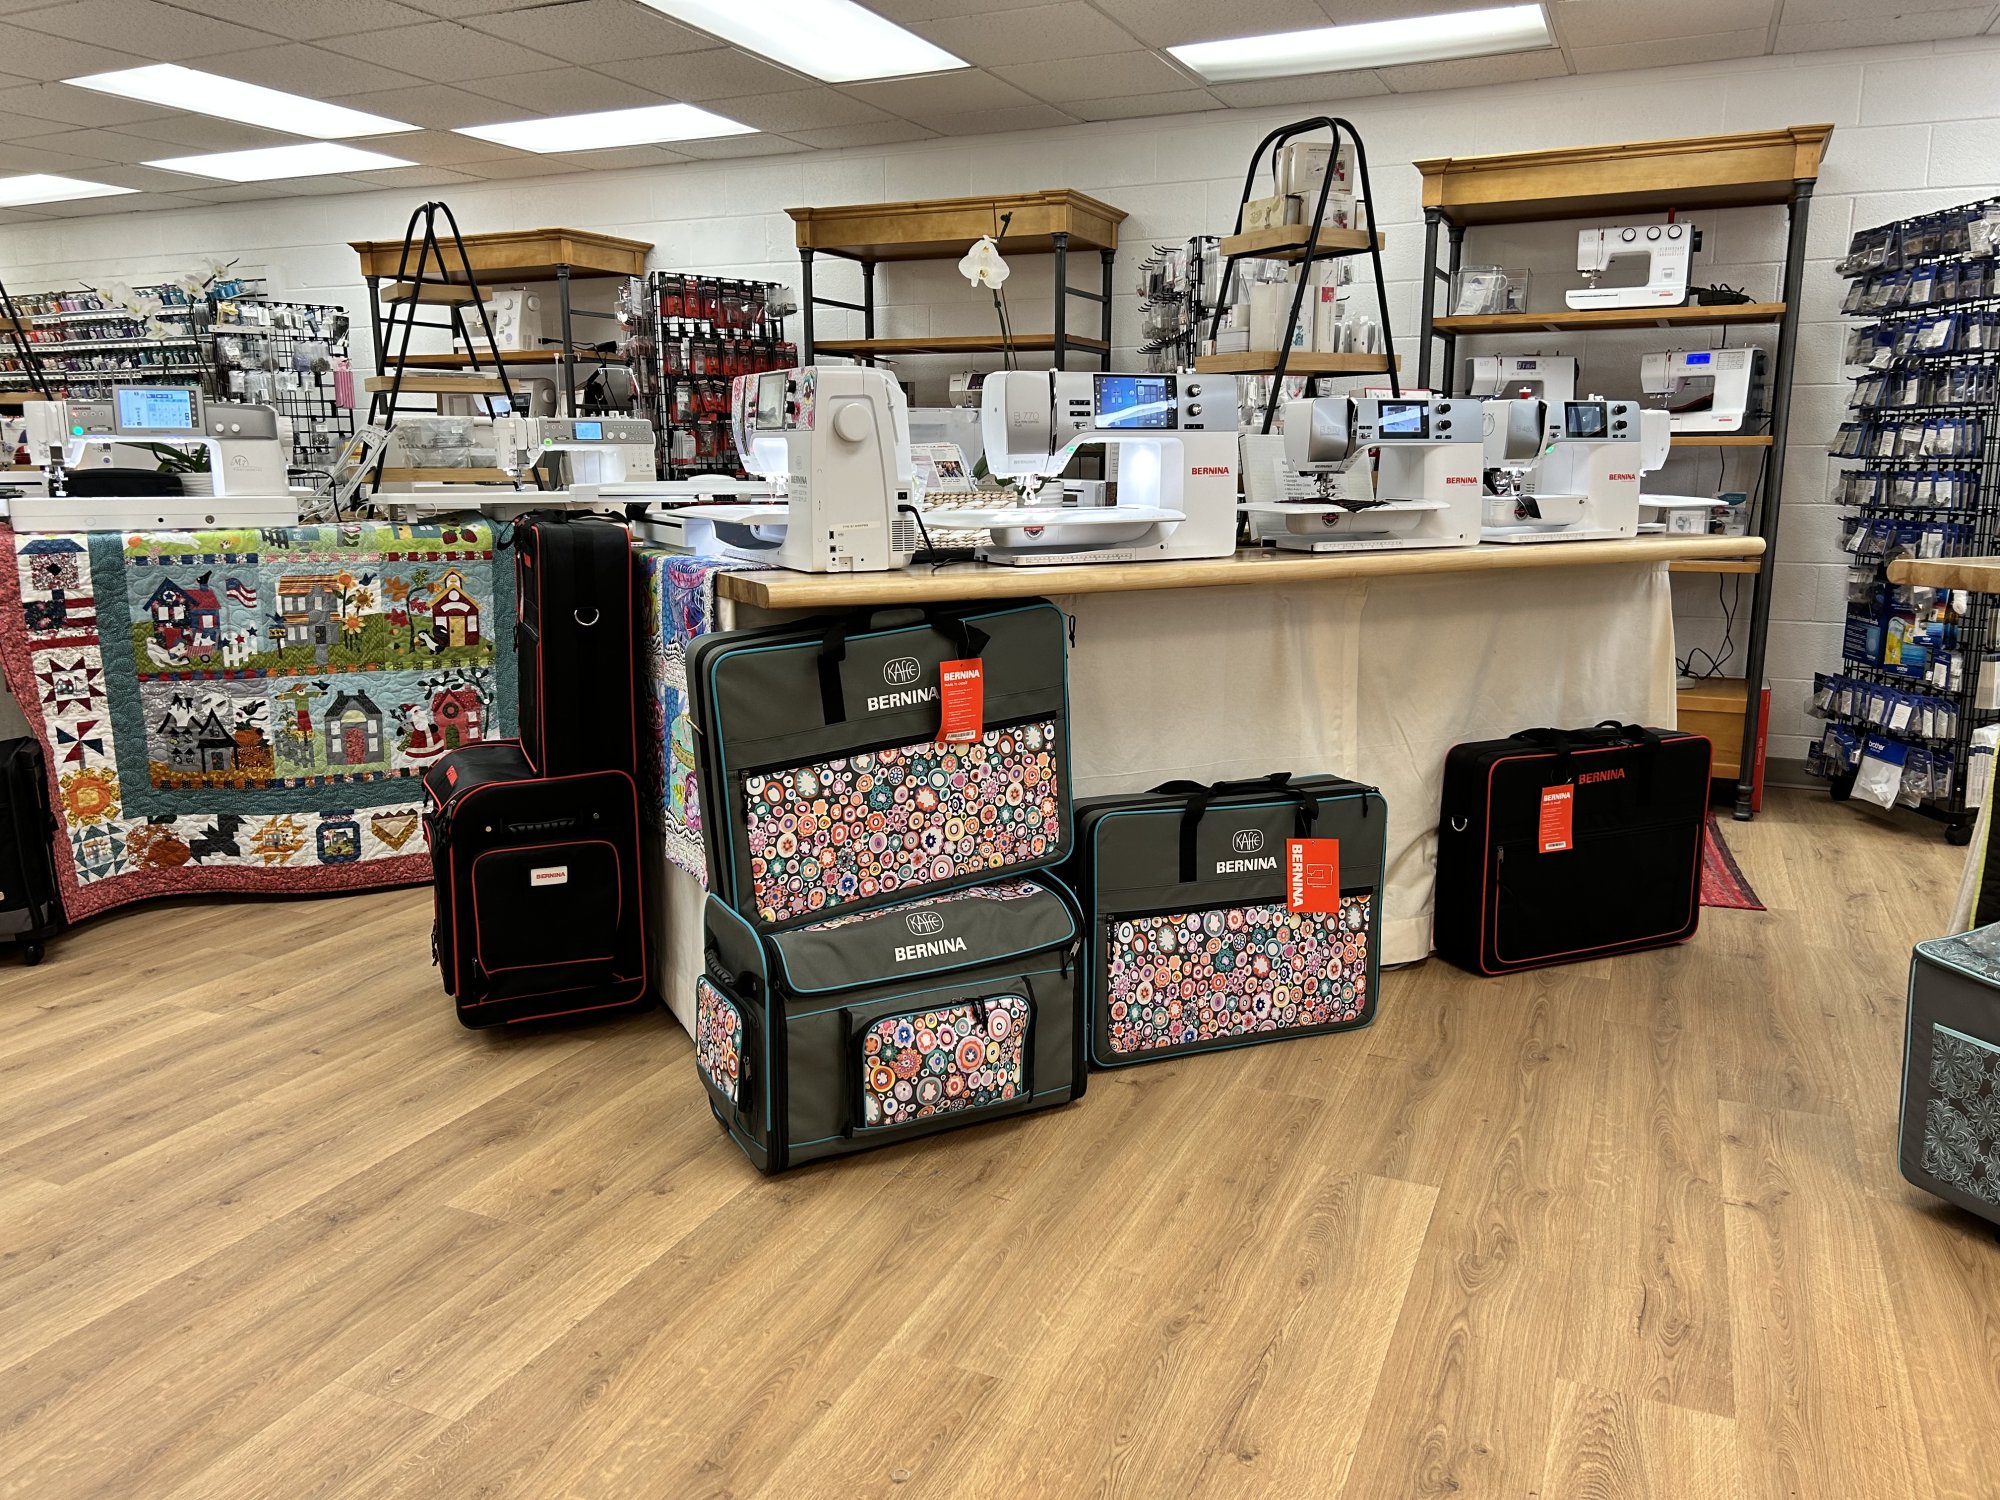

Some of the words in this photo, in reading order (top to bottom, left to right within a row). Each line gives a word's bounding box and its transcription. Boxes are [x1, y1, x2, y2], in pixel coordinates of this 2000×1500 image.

[1023, 411, 1040, 420] 770
[1191, 466, 1230, 476] BERNINA
[1608, 473, 1636, 481] BERNINA
[1446, 476, 1478, 484] BERNINA
[943, 669, 981, 682] BERNINA
[867, 686, 940, 712] BERNINA
[1868, 739, 1886, 751] brother
[1578, 768, 1625, 785] BERNINA
[1543, 791, 1571, 802] BERNINA
[1216, 856, 1278, 874] BERNINA
[536, 871, 566, 880] BERNINA
[1291, 843, 1305, 908] BERNINA
[894, 936, 968, 963] BERNINA
